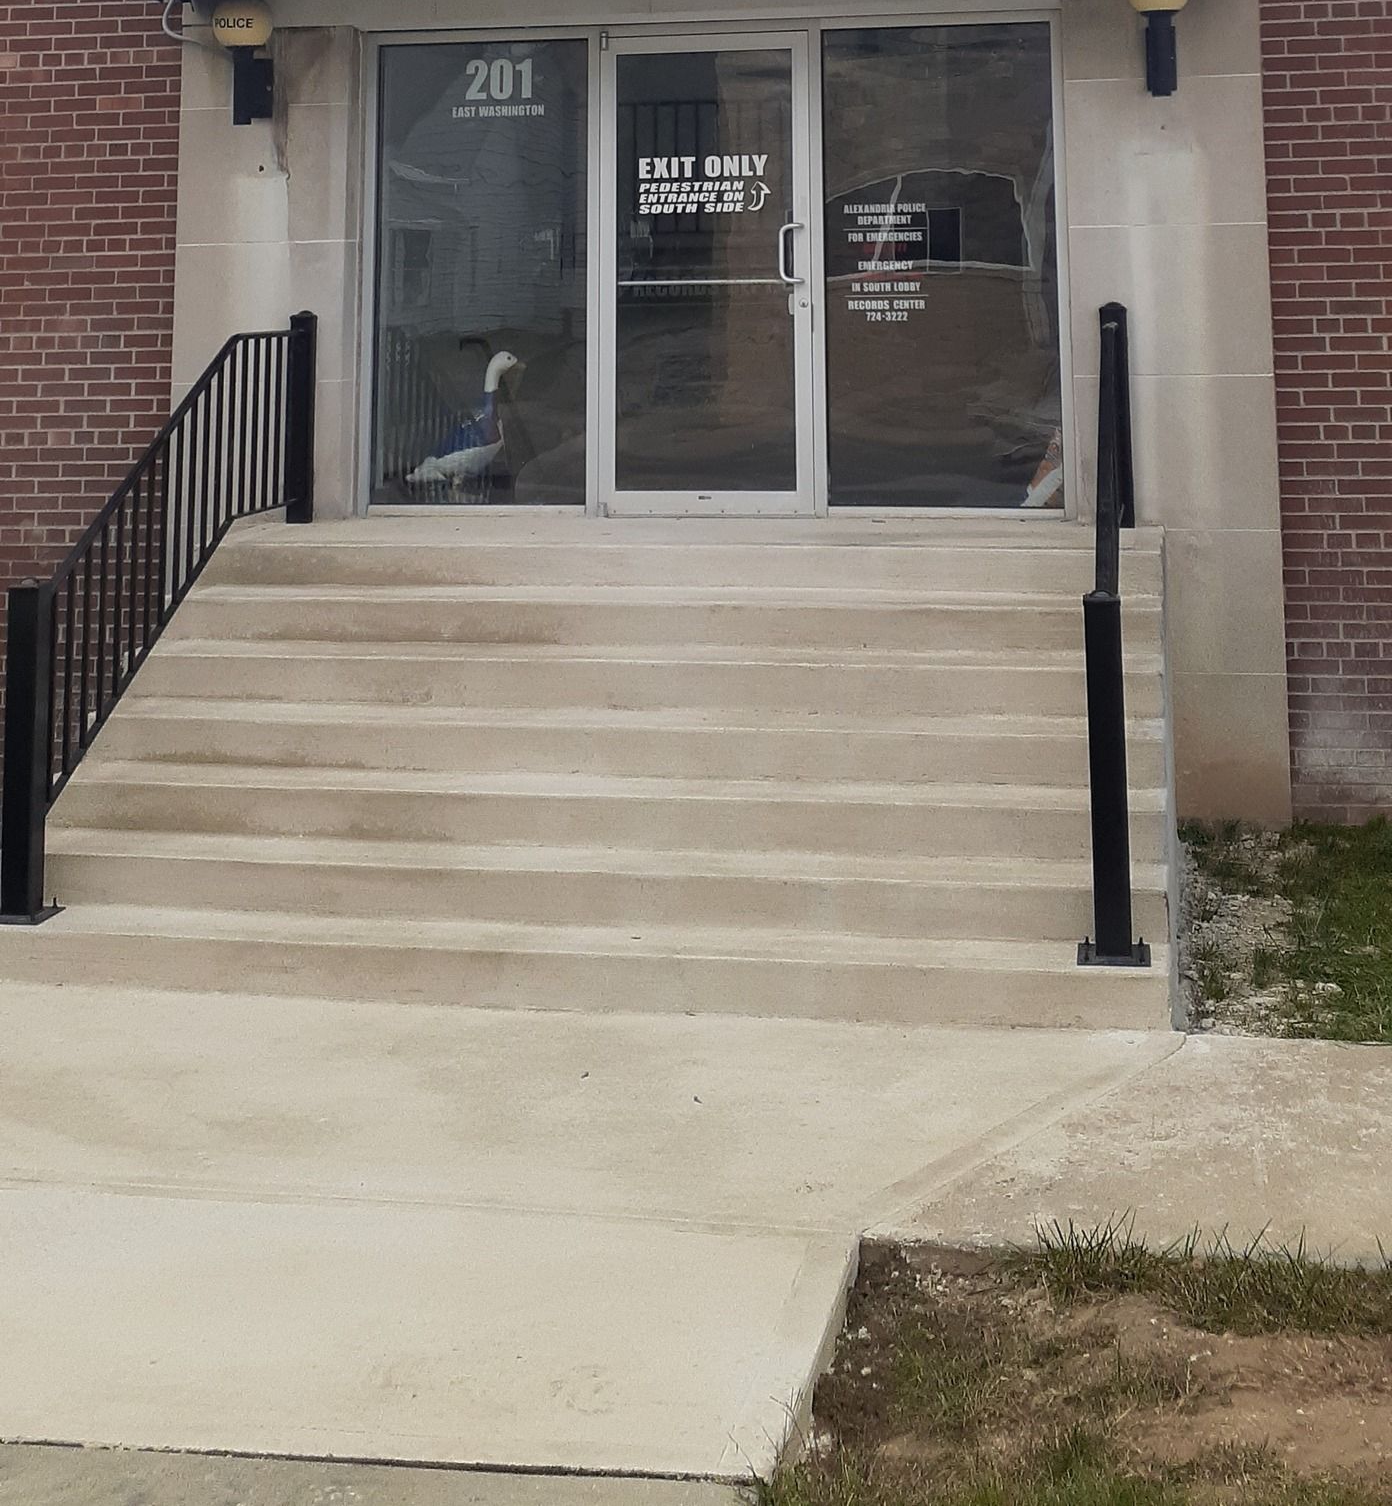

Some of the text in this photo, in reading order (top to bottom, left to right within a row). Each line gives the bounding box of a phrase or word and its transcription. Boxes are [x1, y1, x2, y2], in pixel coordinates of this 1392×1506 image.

[215, 18, 253, 28] POLICE
[465, 58, 533, 100] 201
[452, 104, 545, 118] EAST WASHINGTON
[638, 154, 768, 179] EXIT ONLY
[639, 181, 744, 193] PEDESTRIAN
[639, 191, 744, 203] ENTRANCE ON
[639, 202, 744, 215] SOUTH SIDE
[843, 203, 926, 214] ALEXANDRIA POLICE
[857, 215, 912, 225] DEPARTMENT
[848, 232, 922, 242] FOR EMERGENCIES
[858, 260, 913, 271] EMERGENCY
[852, 282, 921, 292] IN SOUTH LOBBY
[848, 300, 925, 310] RECORDS CENTER
[865, 312, 908, 322] 724-3222
